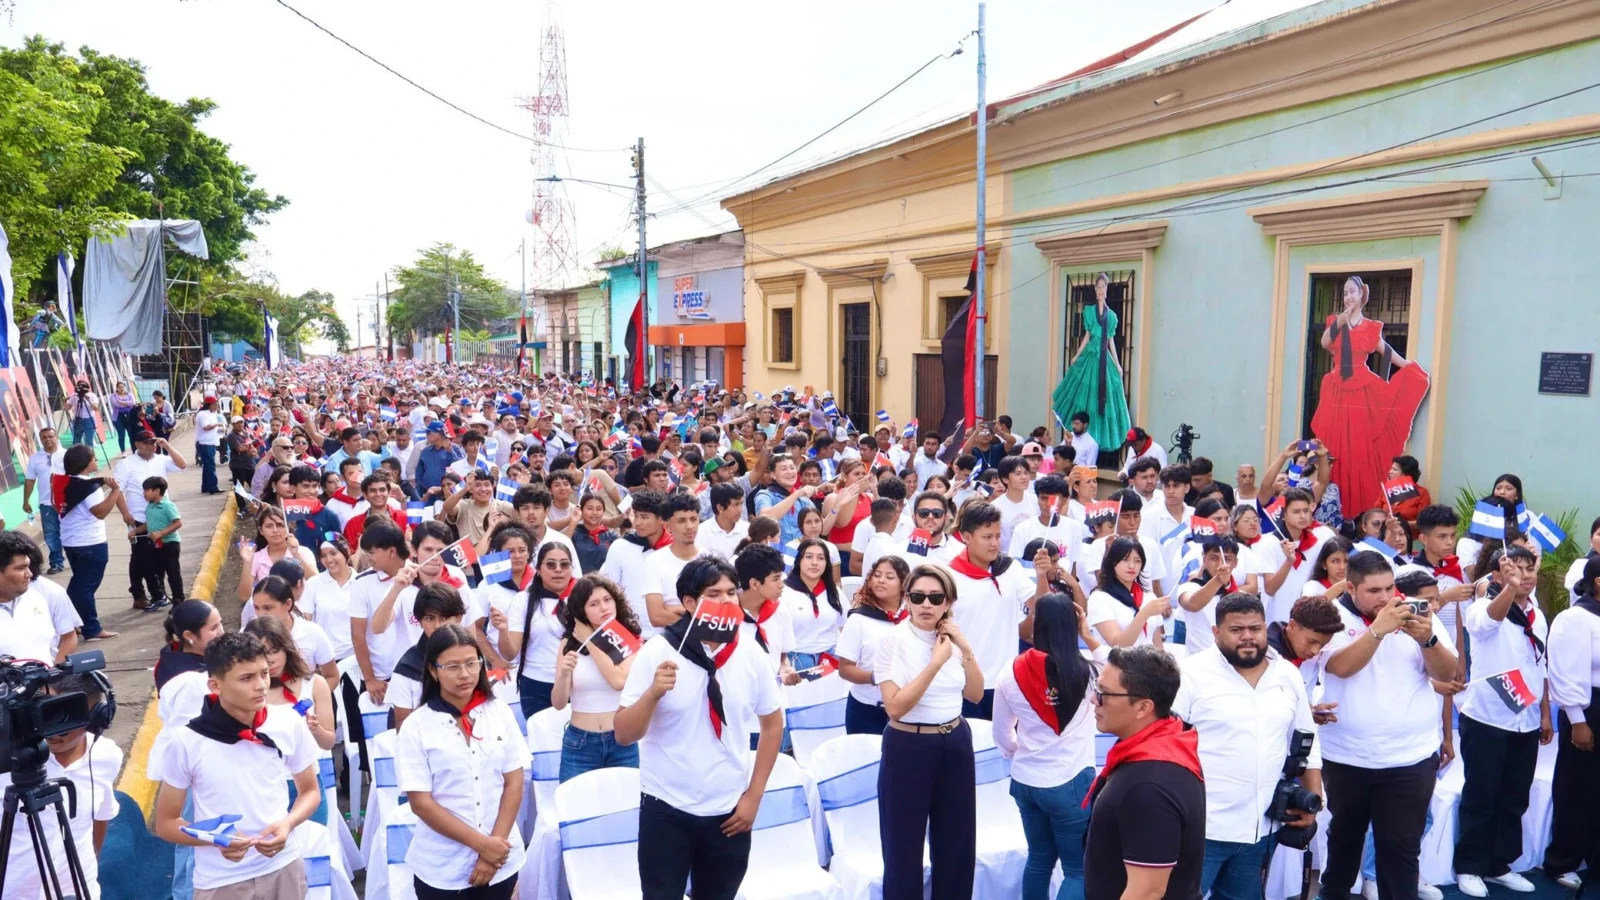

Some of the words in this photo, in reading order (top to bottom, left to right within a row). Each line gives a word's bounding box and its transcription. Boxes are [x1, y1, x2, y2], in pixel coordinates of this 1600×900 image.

[673, 292, 703, 309] EXPRESS
[1387, 482, 1415, 498] FSLN
[450, 543, 470, 569] FSLN
[697, 612, 737, 631] FSLN
[600, 628, 633, 659] FSLN
[1497, 673, 1526, 707] FSLN
